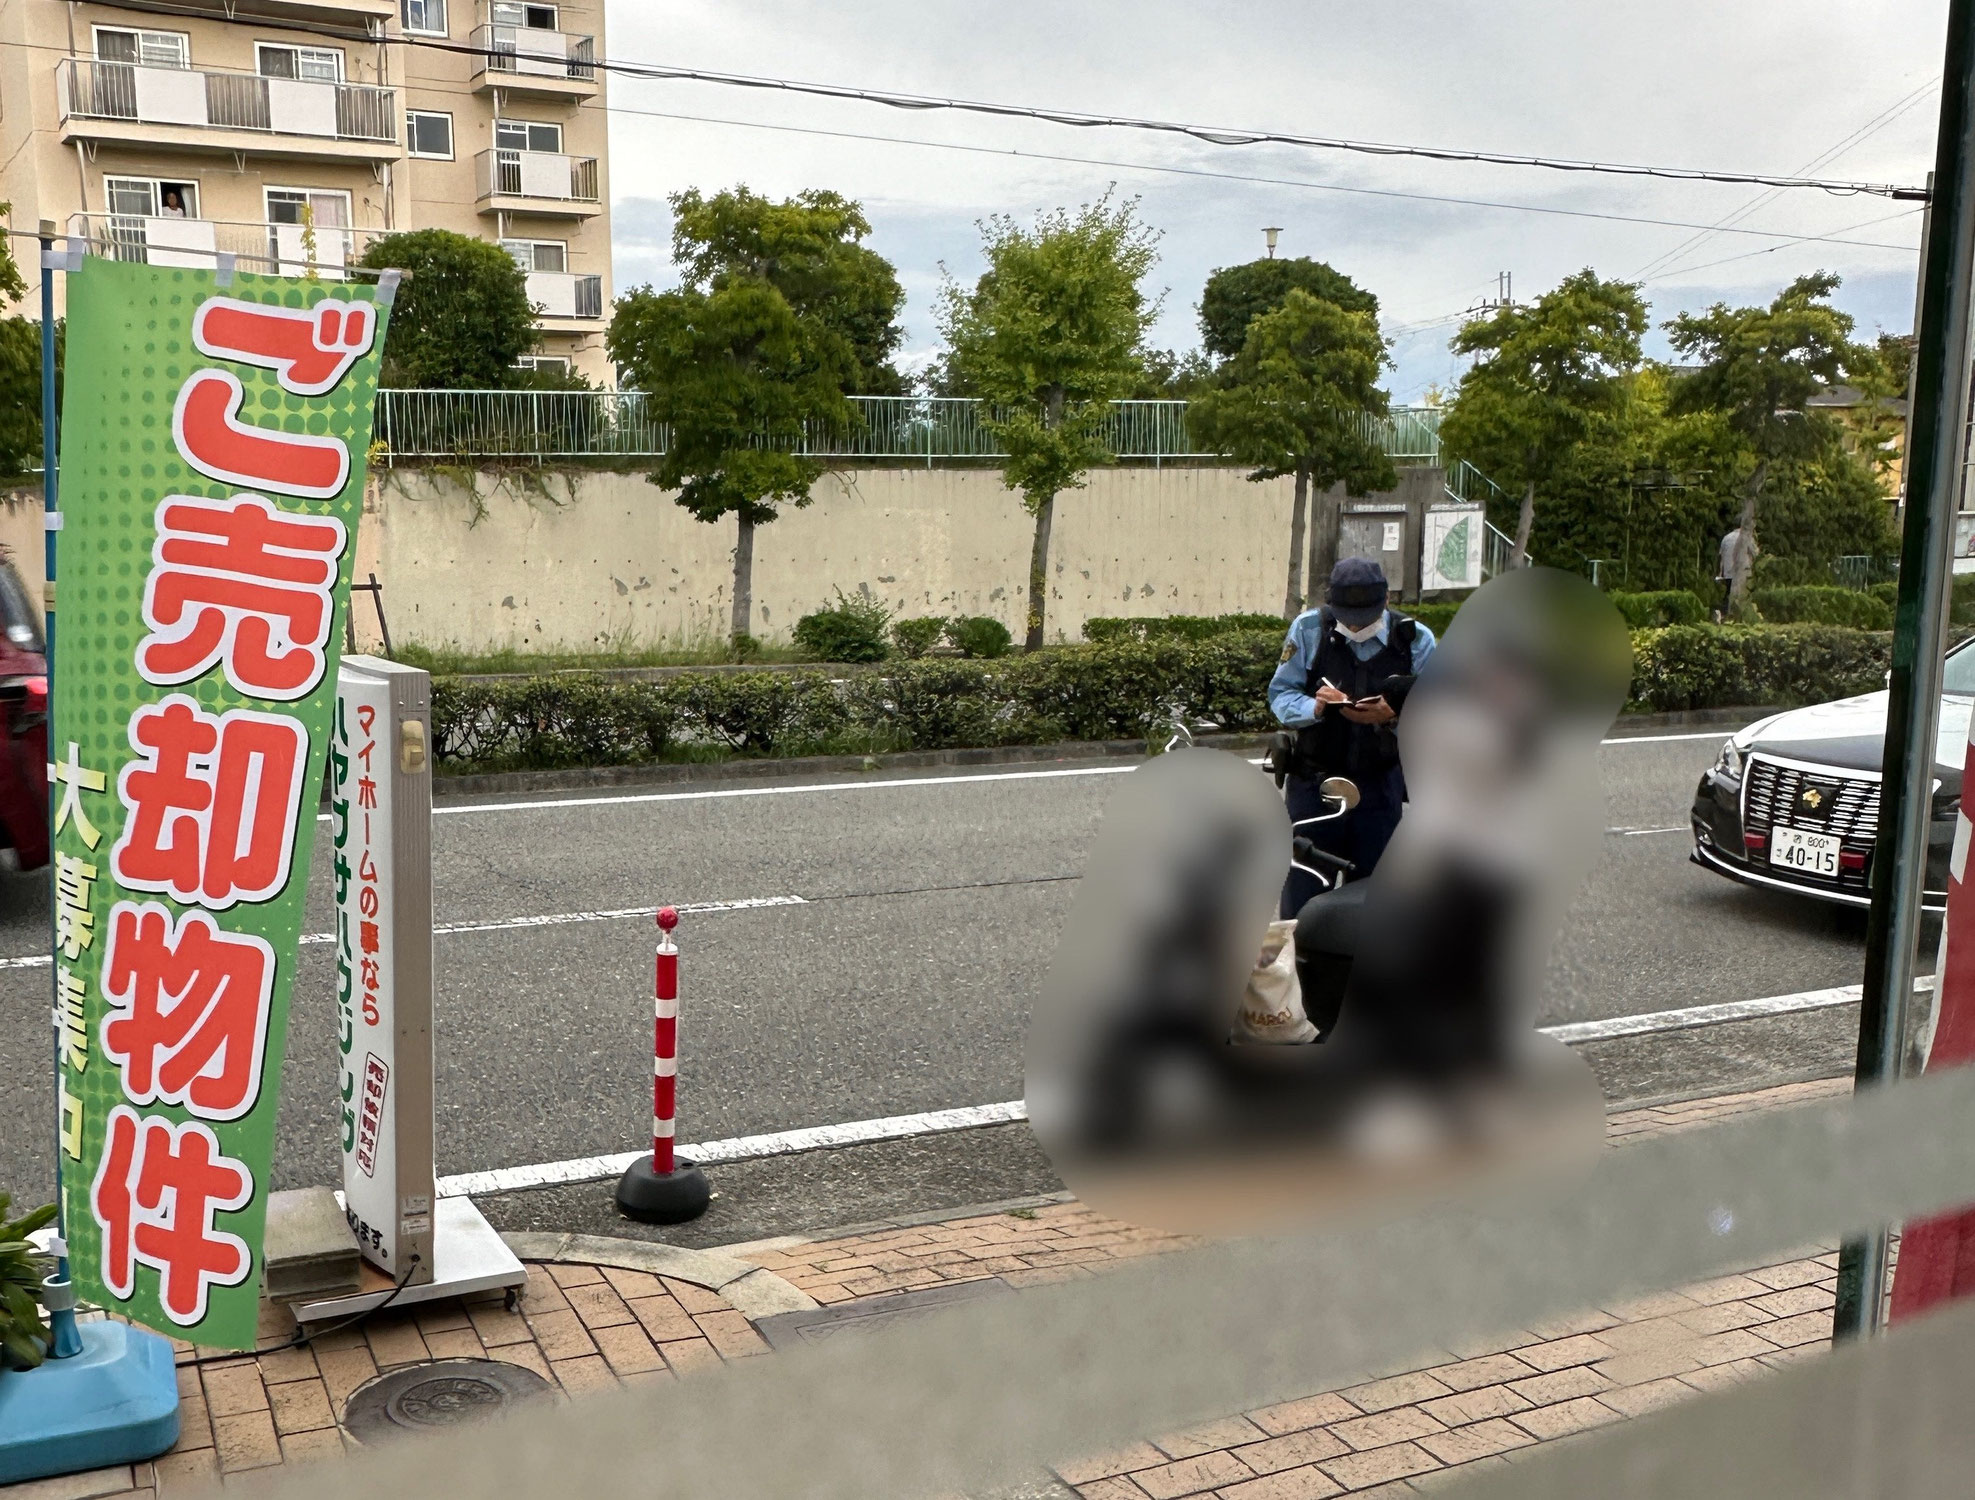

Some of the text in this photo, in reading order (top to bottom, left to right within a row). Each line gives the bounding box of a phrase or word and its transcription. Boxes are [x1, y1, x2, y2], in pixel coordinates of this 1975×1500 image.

[55, 741, 106, 1240] 大募集中
[93, 297, 375, 1324] ご売却物件
[357, 705, 380, 1026] マイホームの事なら
[1785, 845, 1835, 872] 40-15
